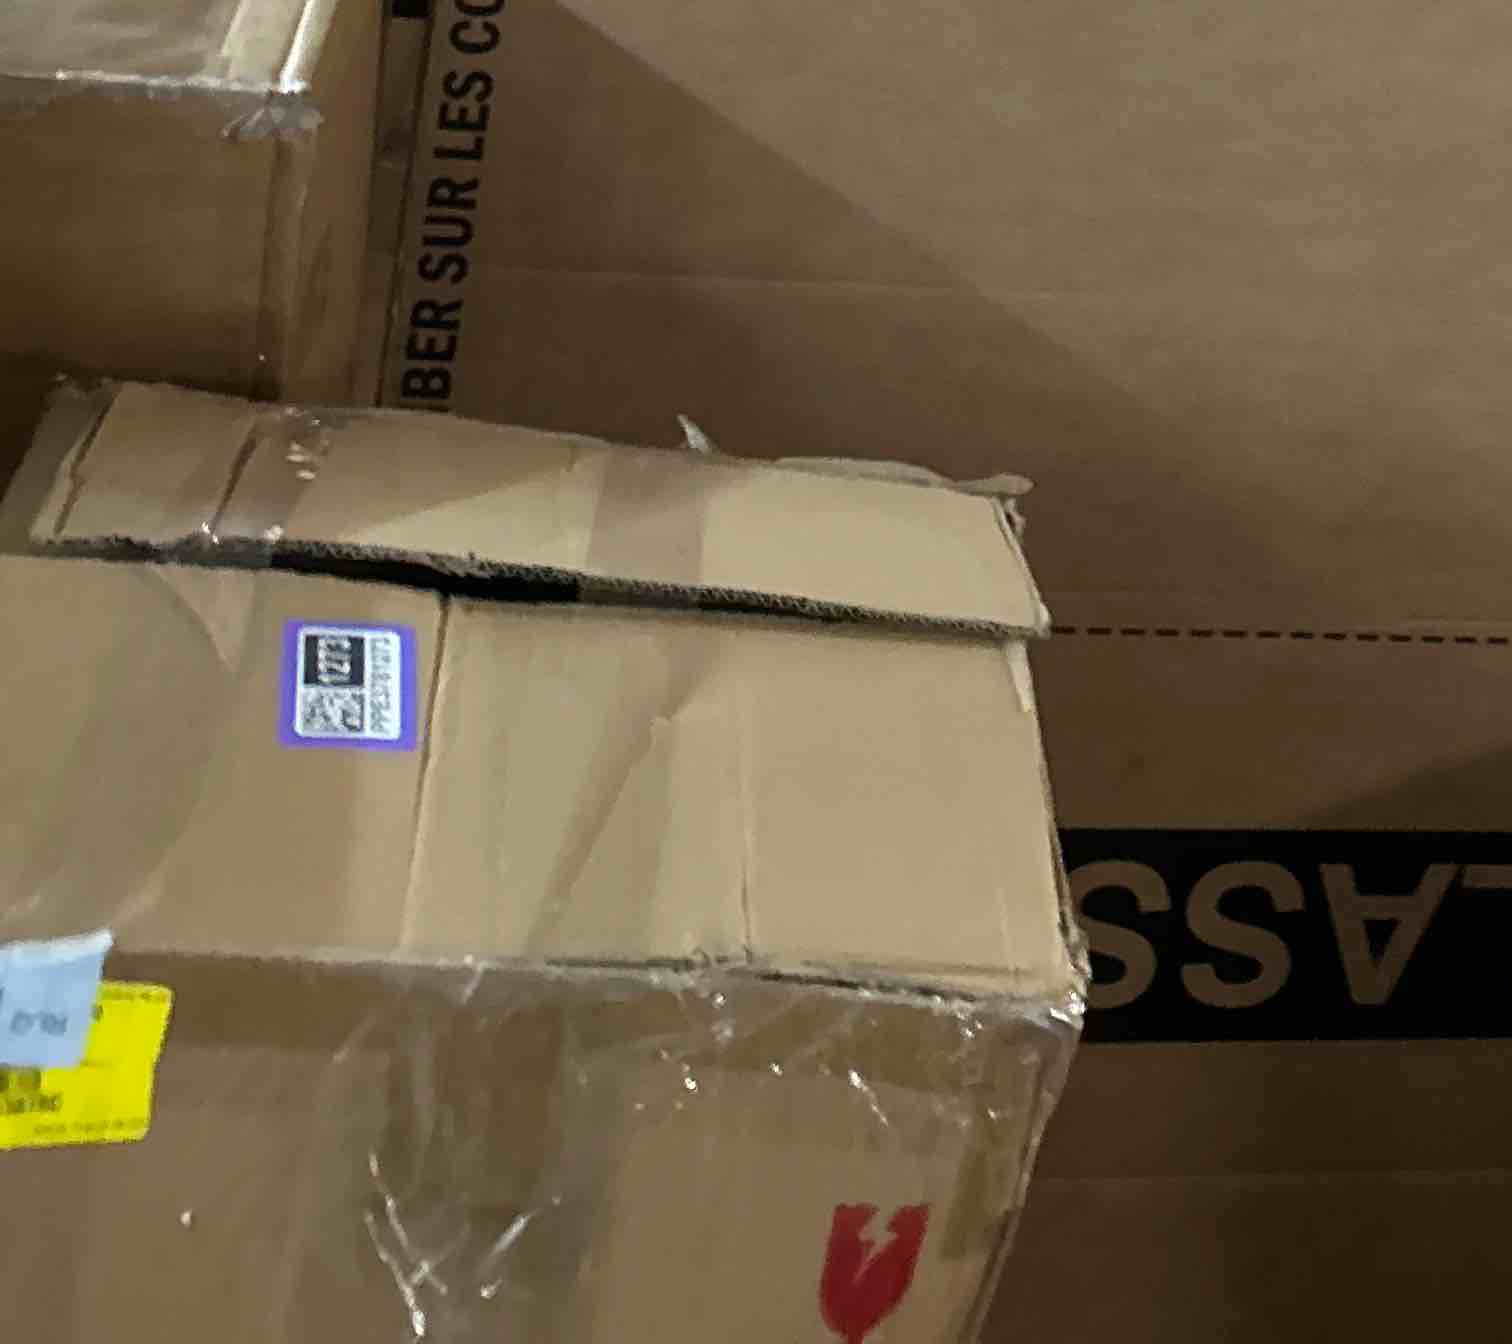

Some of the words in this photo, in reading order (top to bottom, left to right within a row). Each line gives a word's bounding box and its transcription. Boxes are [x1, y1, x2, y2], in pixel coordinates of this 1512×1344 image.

[433, 70, 496, 162] LES
[418, 177, 479, 285] SUR
[401, 298, 465, 401] BER
